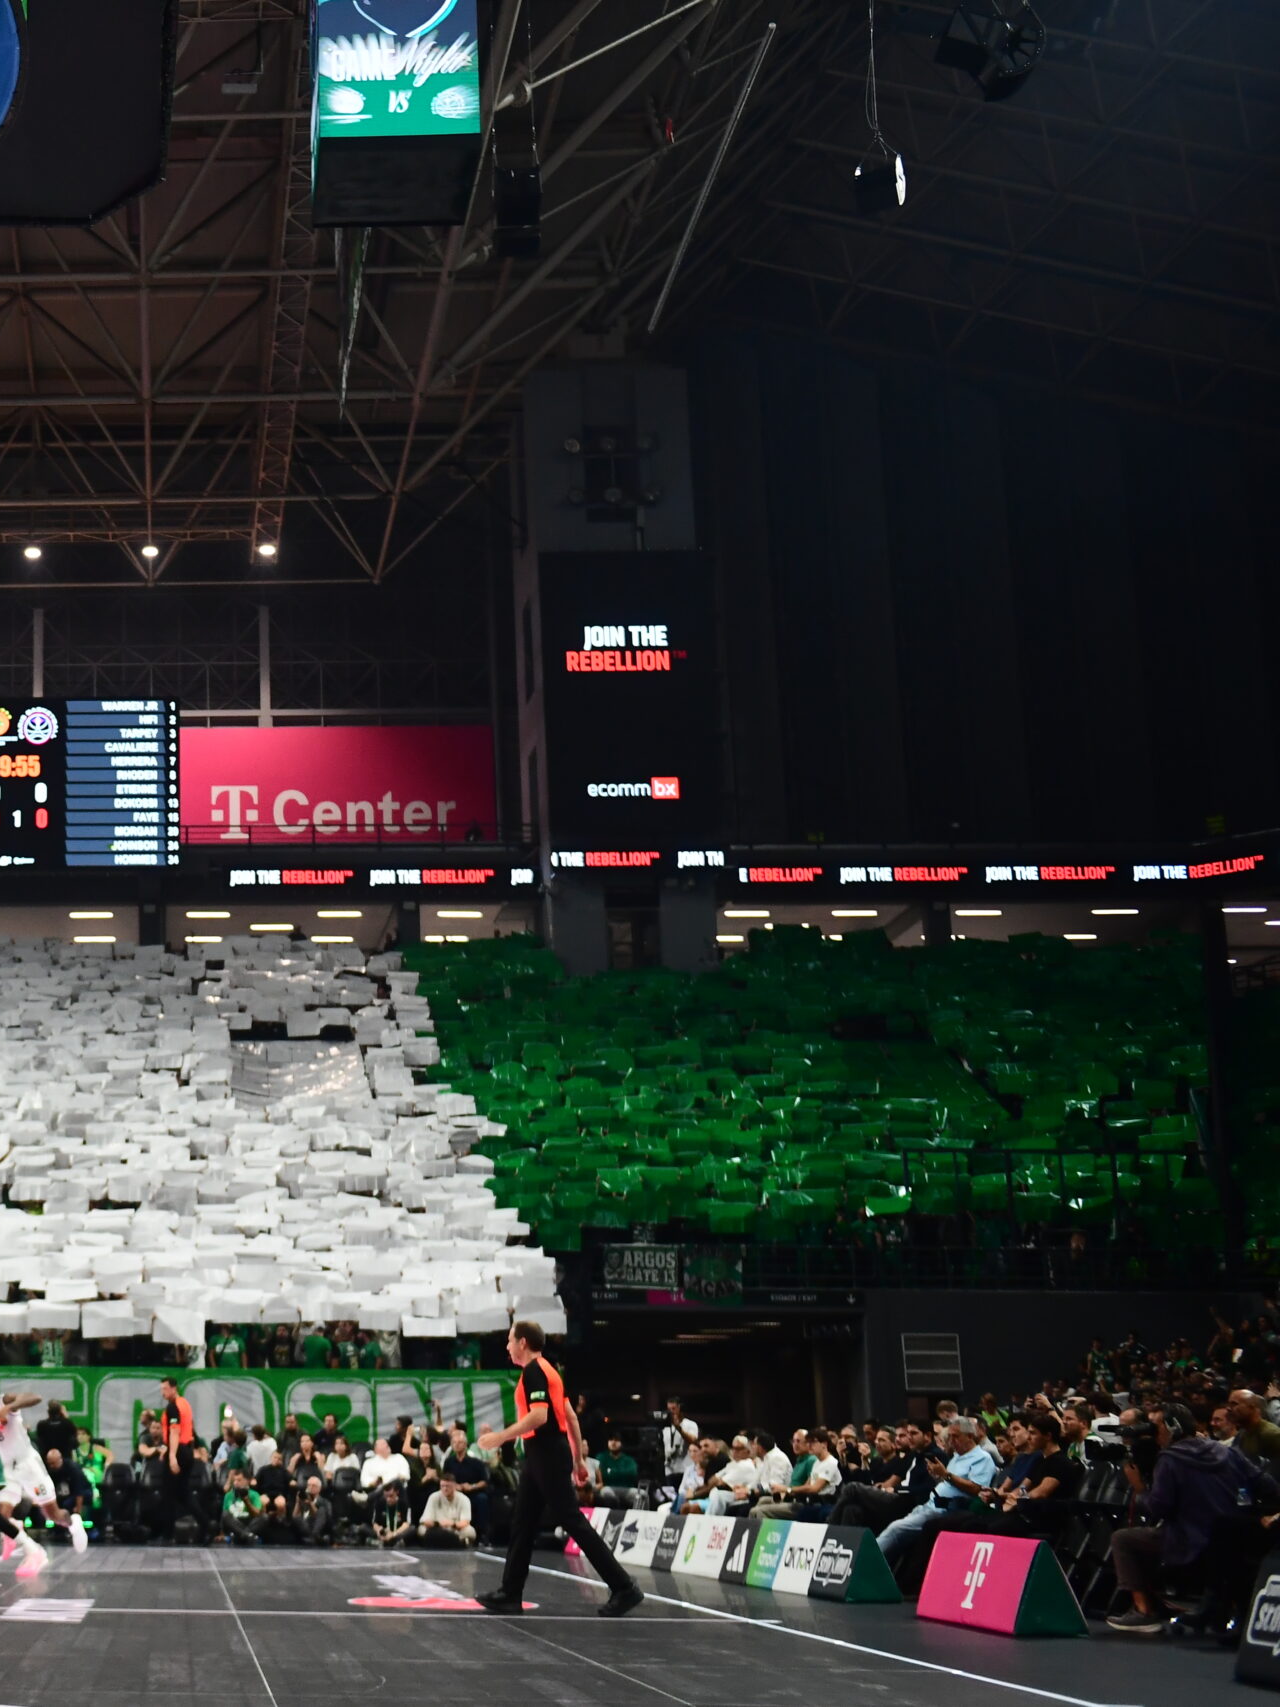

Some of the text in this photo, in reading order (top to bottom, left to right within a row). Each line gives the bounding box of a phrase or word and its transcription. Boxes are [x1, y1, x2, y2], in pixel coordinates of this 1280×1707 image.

[388, 90, 412, 113] VS
[583, 625, 668, 650] JOIN THE
[169, 701, 176, 711] 1
[169, 715, 176, 725] 2
[169, 729, 176, 738] 3
[169, 743, 176, 752] 4
[169, 756, 176, 766] 7
[34, 782, 48, 803] 0
[12, 810, 22, 828] 1
[35, 808, 48, 829] 0
[274, 789, 456, 834] Center
[677, 851, 704, 868] JOIN
[230, 870, 256, 887] JOIN
[257, 870, 281, 885] THE
[370, 869, 396, 887] JOIN
[397, 869, 421, 885] THE
[840, 867, 866, 884] JOIN
[867, 867, 893, 882] THE
[985, 866, 1012, 883] JOIN
[1013, 866, 1039, 881] THE
[1133, 866, 1160, 882] JOIN
[1162, 866, 1187, 880] THE
[623, 1250, 676, 1268] ARGOS
[627, 1268, 658, 1282] GATE
